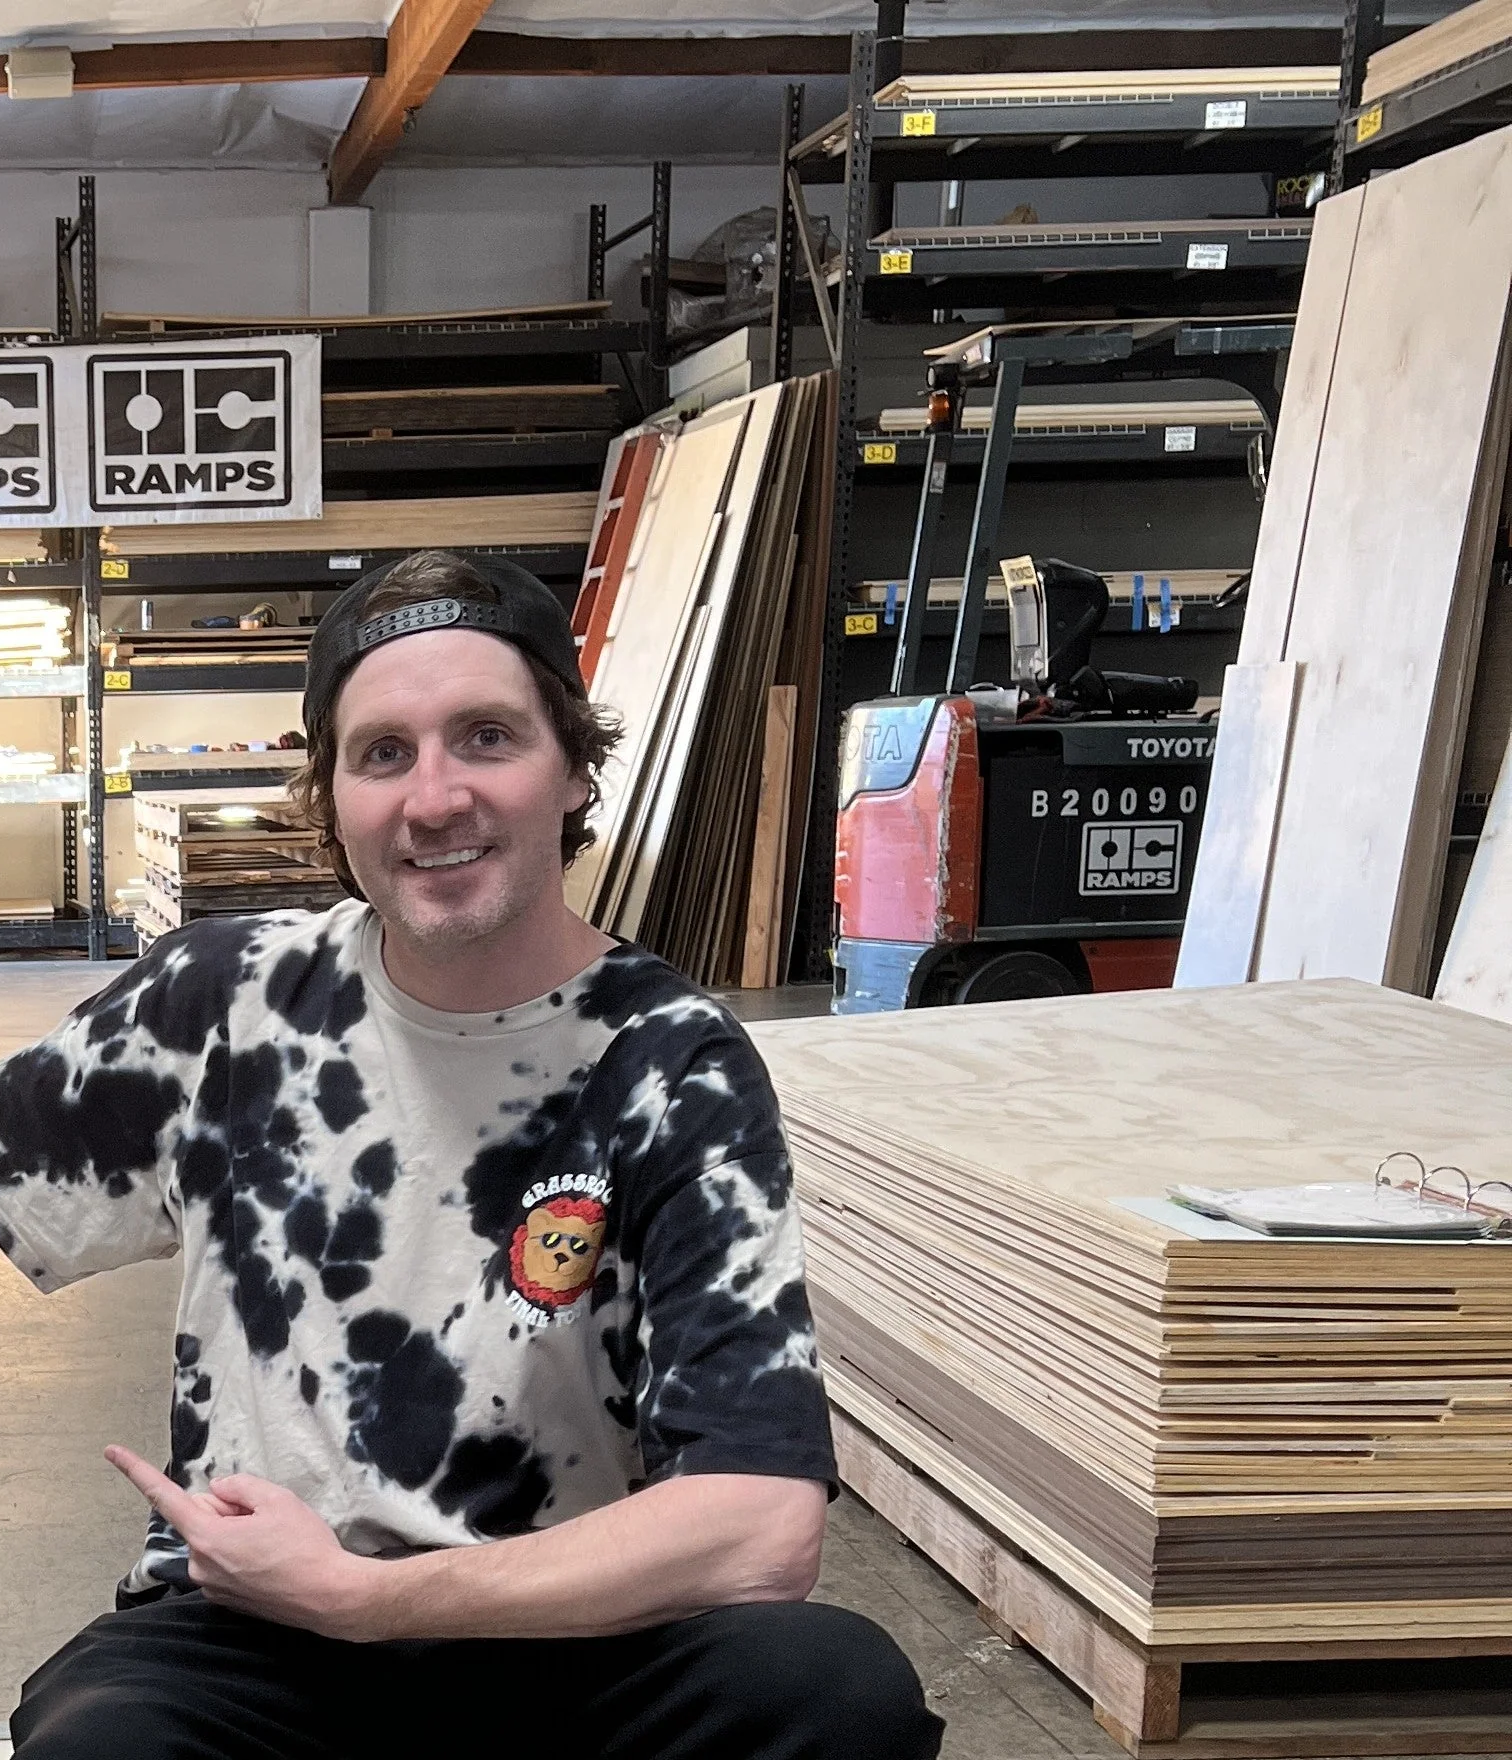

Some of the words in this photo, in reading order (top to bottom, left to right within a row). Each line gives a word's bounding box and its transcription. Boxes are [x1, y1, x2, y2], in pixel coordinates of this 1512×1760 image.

[906, 115, 932, 132] 3-F
[882, 255, 909, 271] 3-E
[866, 445, 893, 461] 3-D
[104, 460, 275, 496] RAMPS
[103, 561, 126, 576] 2-D
[847, 616, 874, 632] 3-C
[107, 674, 129, 686] 2-C
[1086, 870, 1172, 889] RAMPS
